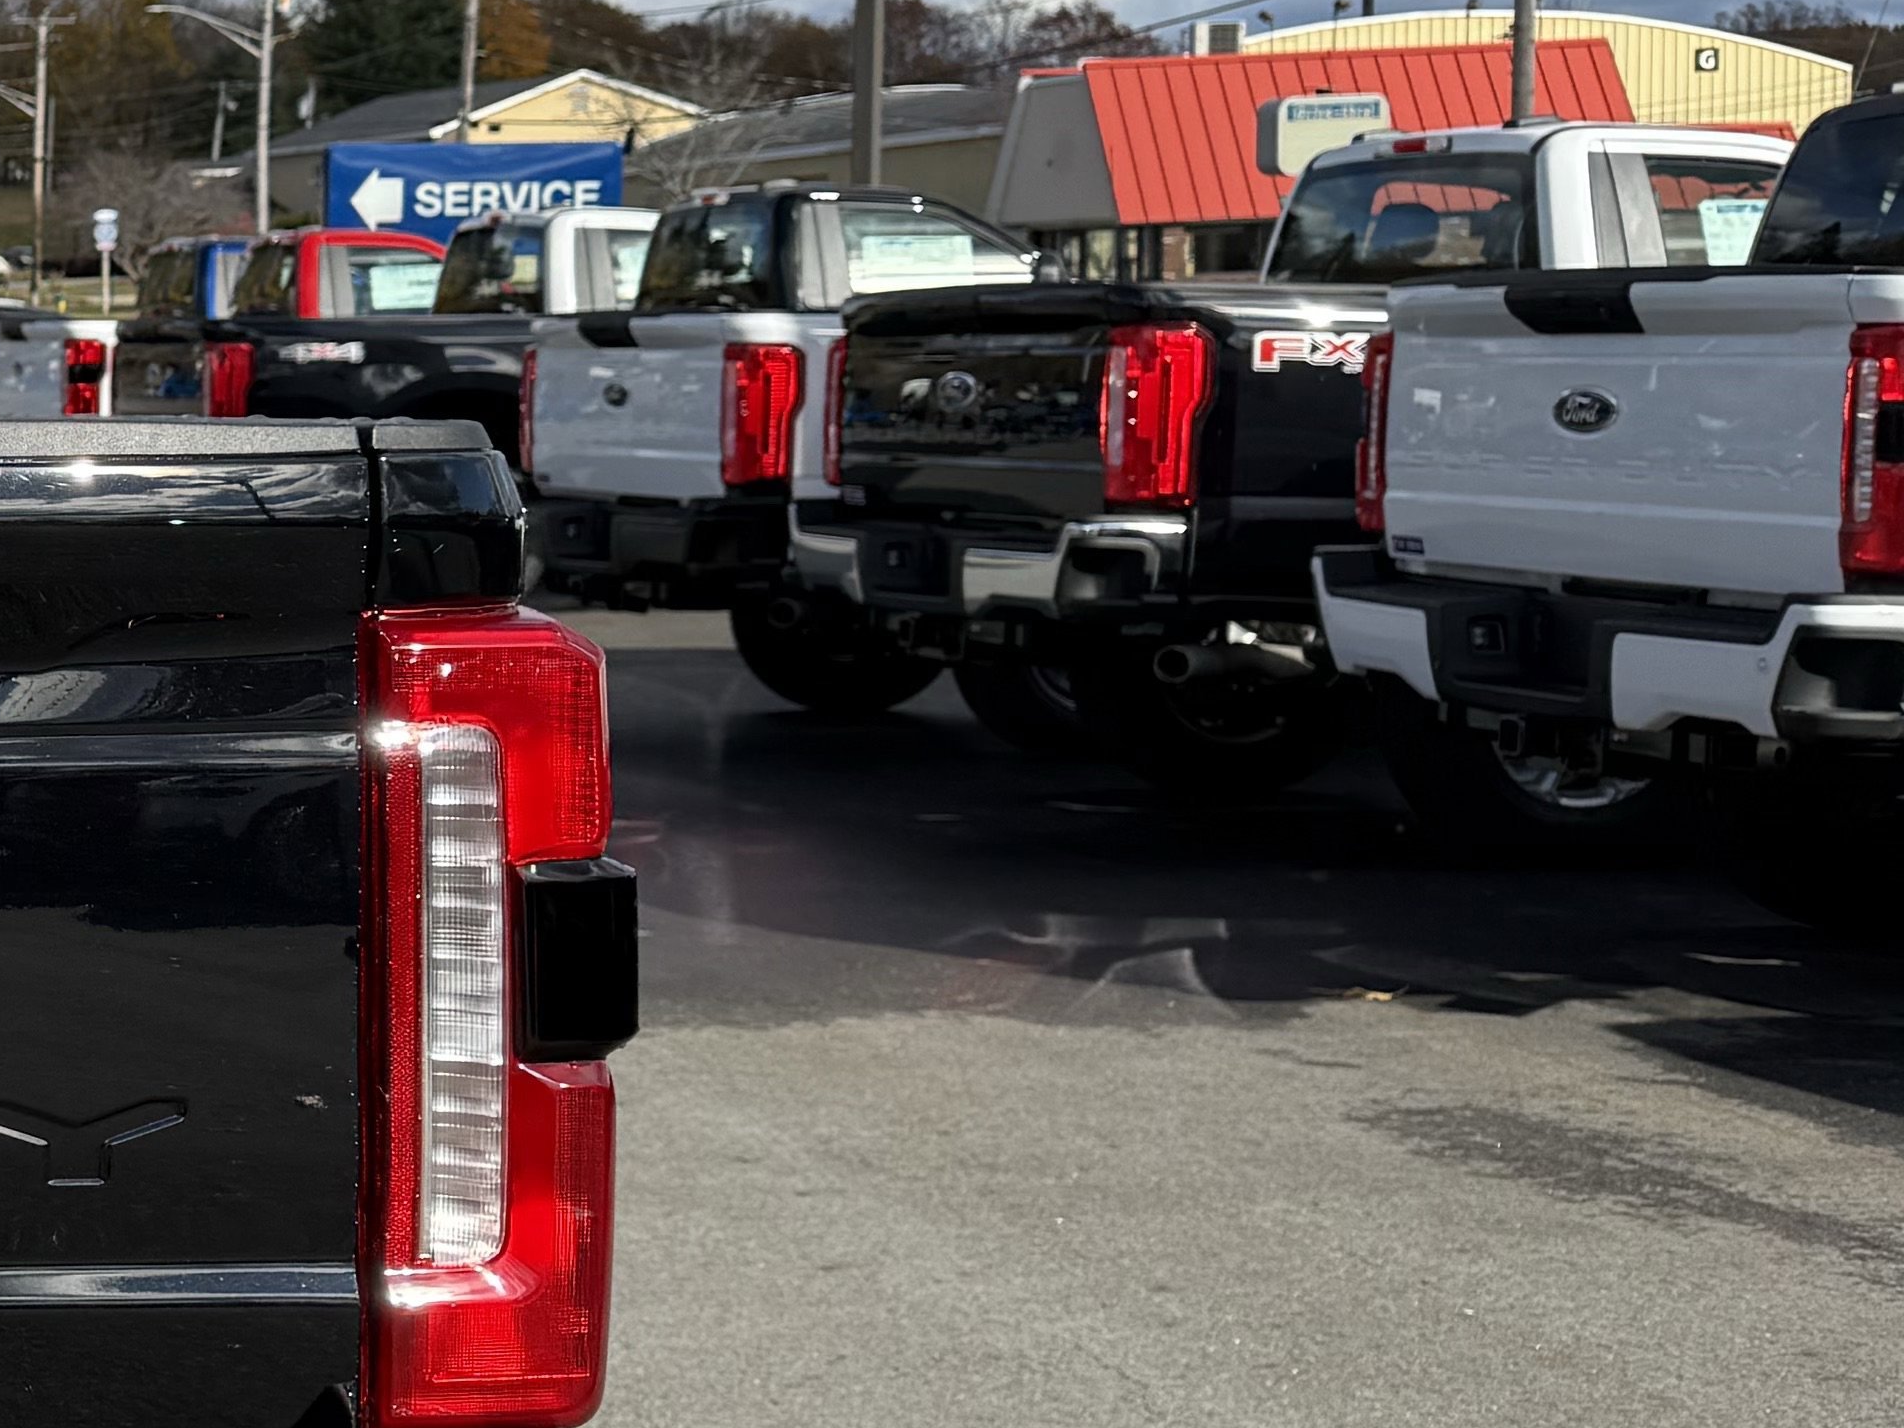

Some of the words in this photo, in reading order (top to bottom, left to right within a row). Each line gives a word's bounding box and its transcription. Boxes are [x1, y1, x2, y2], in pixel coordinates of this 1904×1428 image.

[1699, 49, 1716, 70] G
[414, 179, 603, 218] SERVICE
[1563, 396, 1601, 423] Ford
